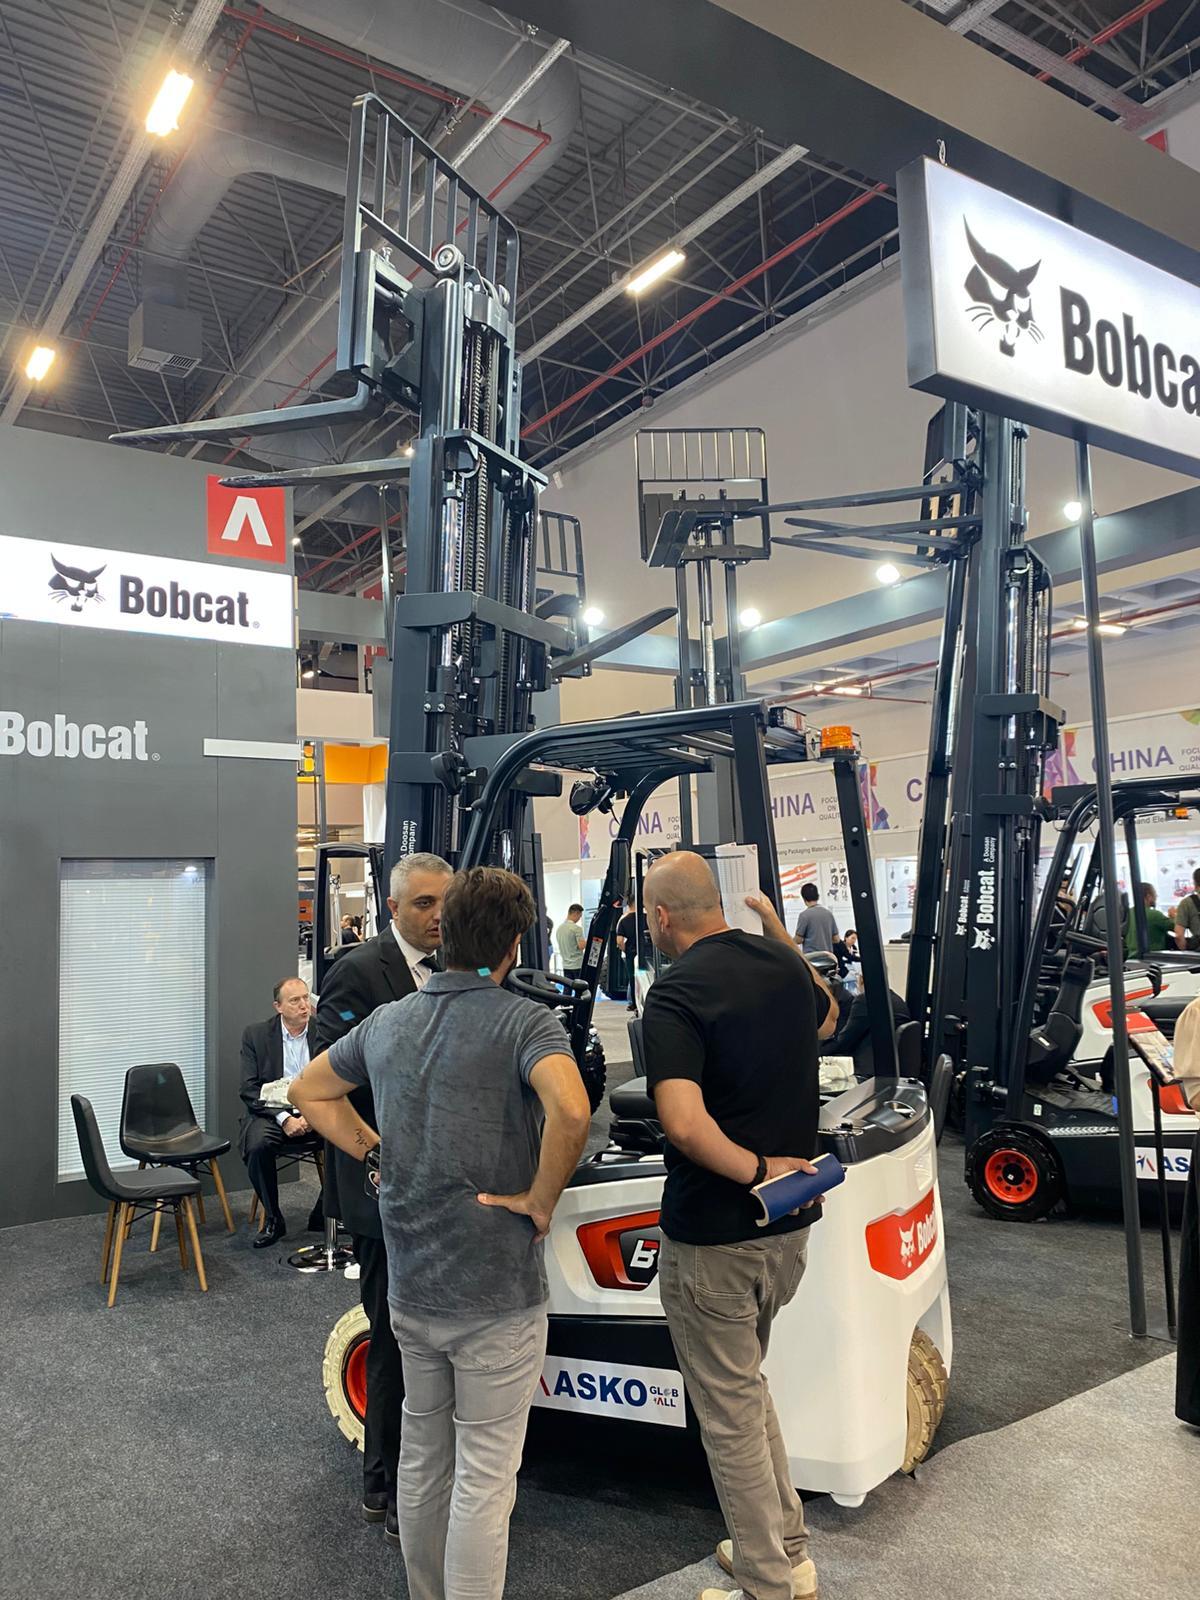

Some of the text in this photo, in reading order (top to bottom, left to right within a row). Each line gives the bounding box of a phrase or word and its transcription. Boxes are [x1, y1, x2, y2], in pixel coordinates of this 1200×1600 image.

[1059, 285, 1200, 418] Bobca
[120, 574, 249, 627] Bobcat
[0, 711, 148, 761] Bobcat
[771, 793, 815, 818] HINA
[819, 812, 840, 820] QUALIT
[401, 820, 409, 851] Doosan
[408, 821, 417, 855] ompany
[609, 811, 662, 838] CNA
[976, 870, 995, 924] Bobcat
[1163, 1156, 1190, 1173] AS
[554, 1370, 648, 1407] ASKO
